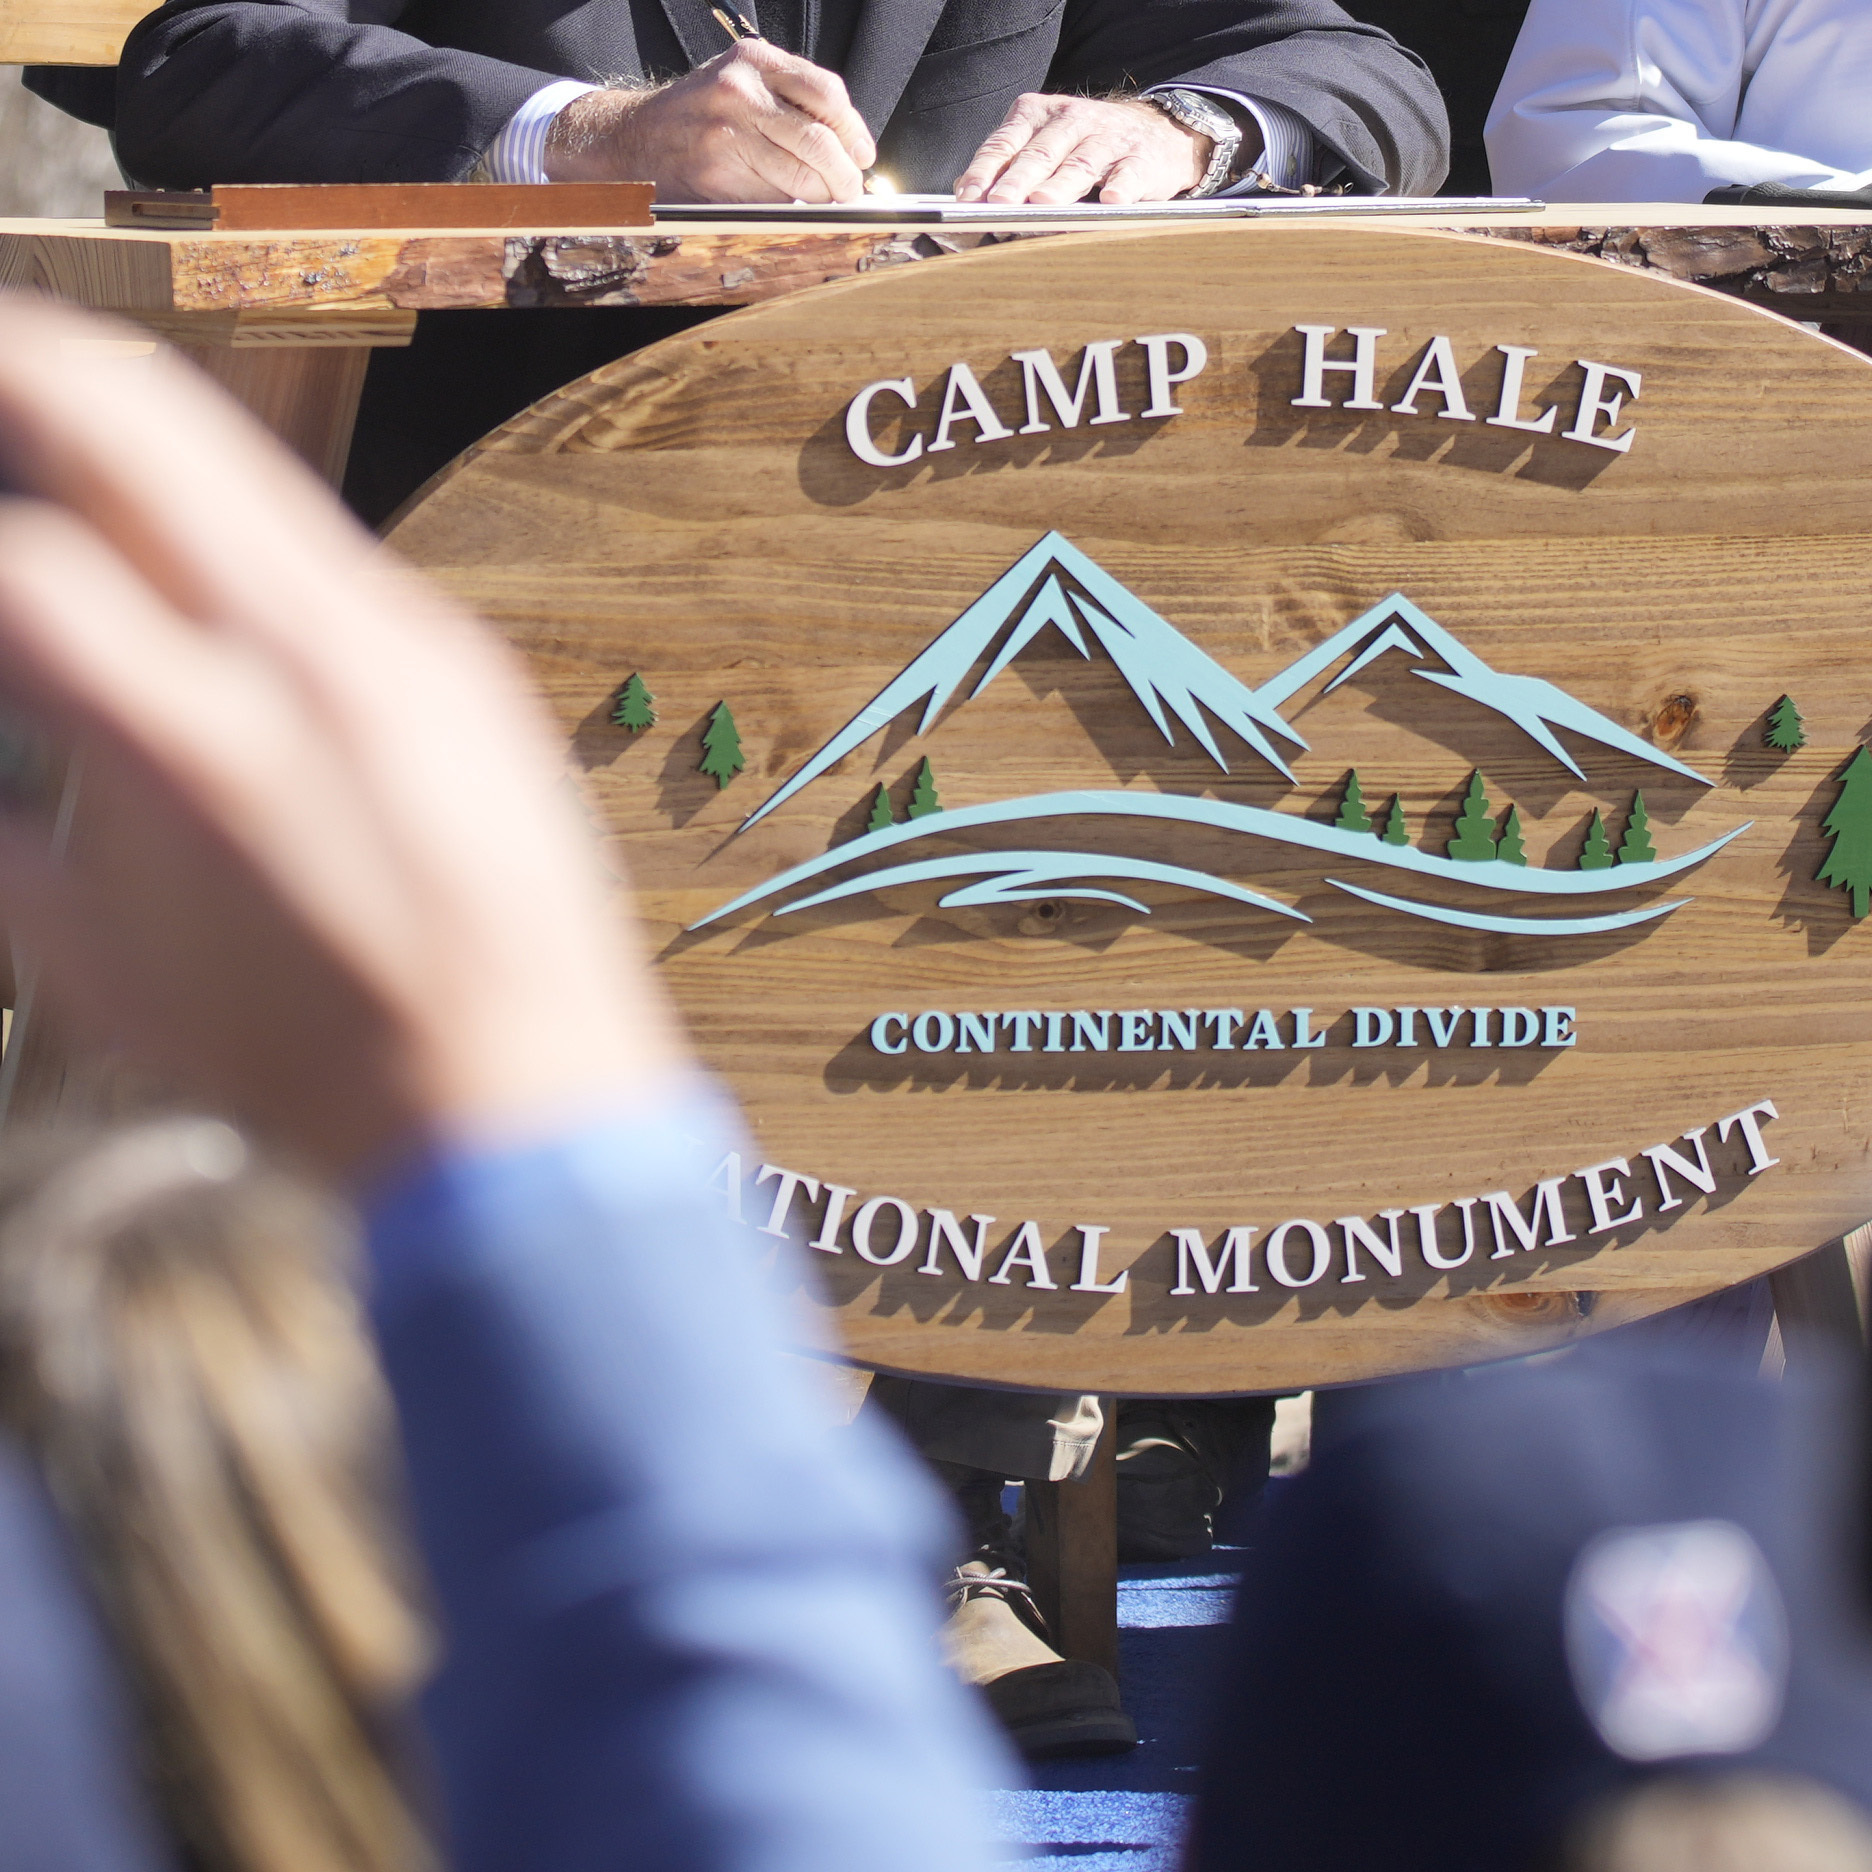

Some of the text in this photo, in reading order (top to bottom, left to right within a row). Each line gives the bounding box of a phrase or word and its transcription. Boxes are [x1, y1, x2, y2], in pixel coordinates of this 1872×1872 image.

[845, 324, 1642, 468] CAMP HALE
[870, 1005, 1577, 1056] CONTINENTAL DIVIDE
[700, 1098, 1781, 1296] ATIONAL MONUMENT
